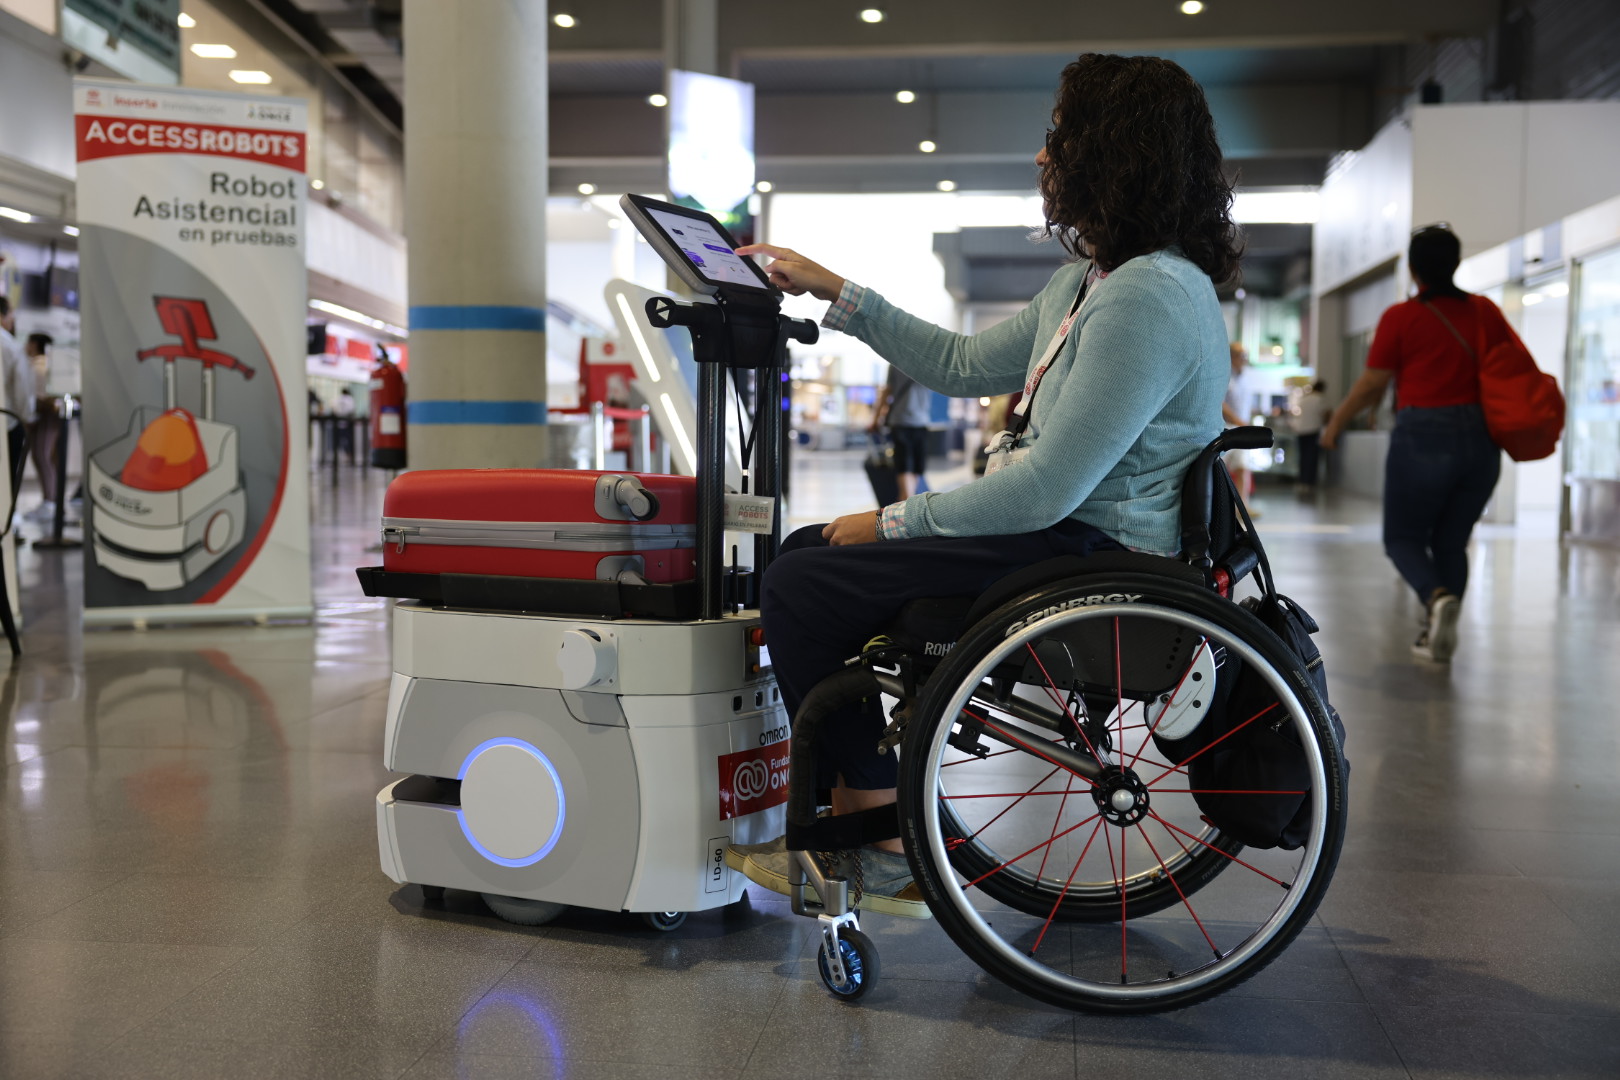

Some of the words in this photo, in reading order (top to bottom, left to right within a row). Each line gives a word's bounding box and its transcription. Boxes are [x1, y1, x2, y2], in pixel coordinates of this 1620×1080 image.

[85, 119, 299, 157] ACCESSROBOTS
[210, 172, 297, 198] Robot
[133, 196, 297, 226] Asistencial
[179, 228, 204, 241] en
[211, 228, 297, 247] pruebas
[738, 511, 769, 519] ROBOTS
[739, 504, 769, 513] ACCESS
[1005, 593, 1144, 637] SPINERGY
[759, 724, 788, 746] OMRON
[713, 848, 723, 881] LD-60
